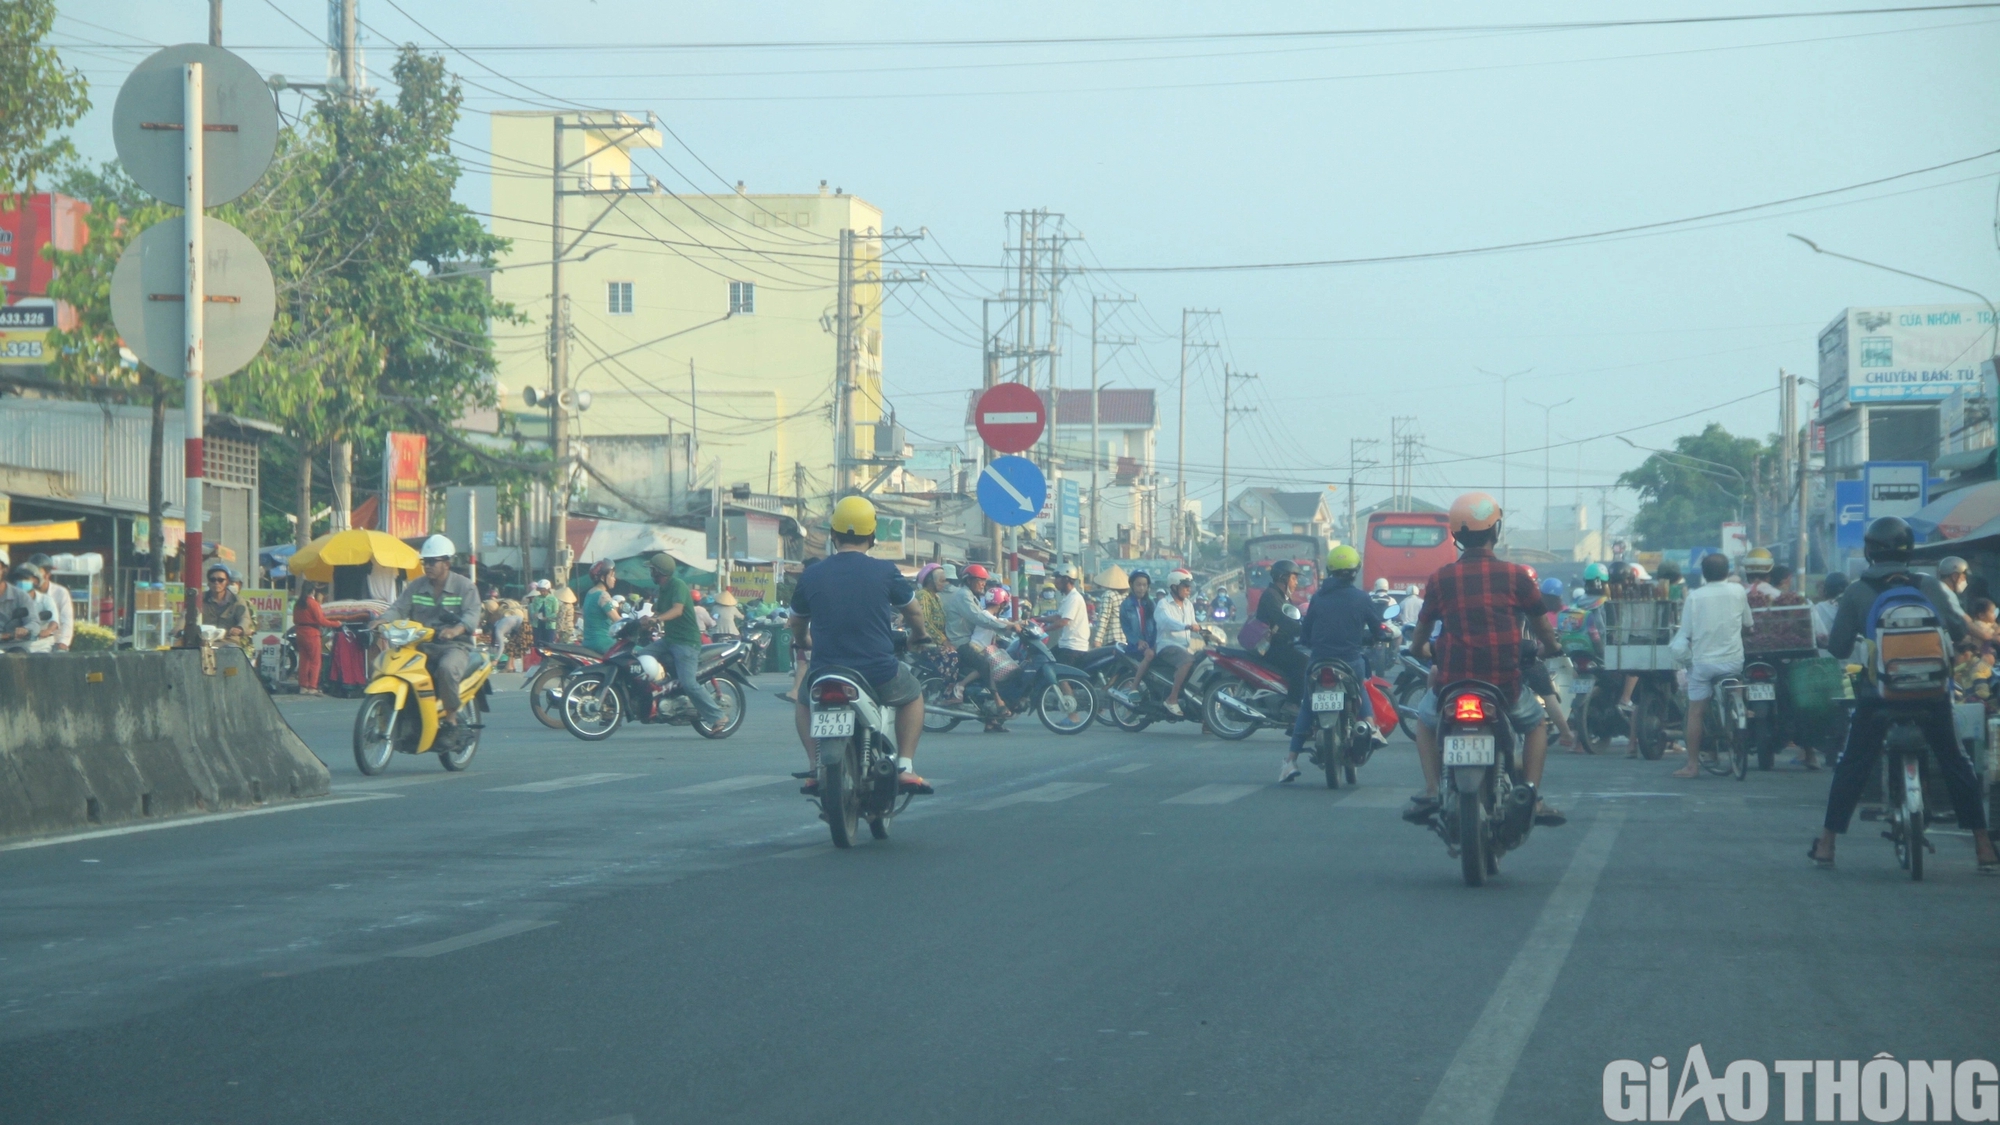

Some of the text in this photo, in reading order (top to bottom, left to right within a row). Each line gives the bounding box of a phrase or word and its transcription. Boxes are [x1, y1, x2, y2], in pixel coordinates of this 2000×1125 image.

[1927, 311, 1962, 326] NHÔM
[1866, 369, 1918, 384] CHUYÊN
[1922, 367, 1953, 382] BÁN:
[1317, 693, 1338, 701] 94-G1
[1313, 702, 1342, 710] 035.83
[818, 713, 847, 724] 94-K1
[814, 724, 851, 736] 762.93
[1452, 739, 1486, 750] 83-E1
[1448, 751, 1491, 763] 361.31
